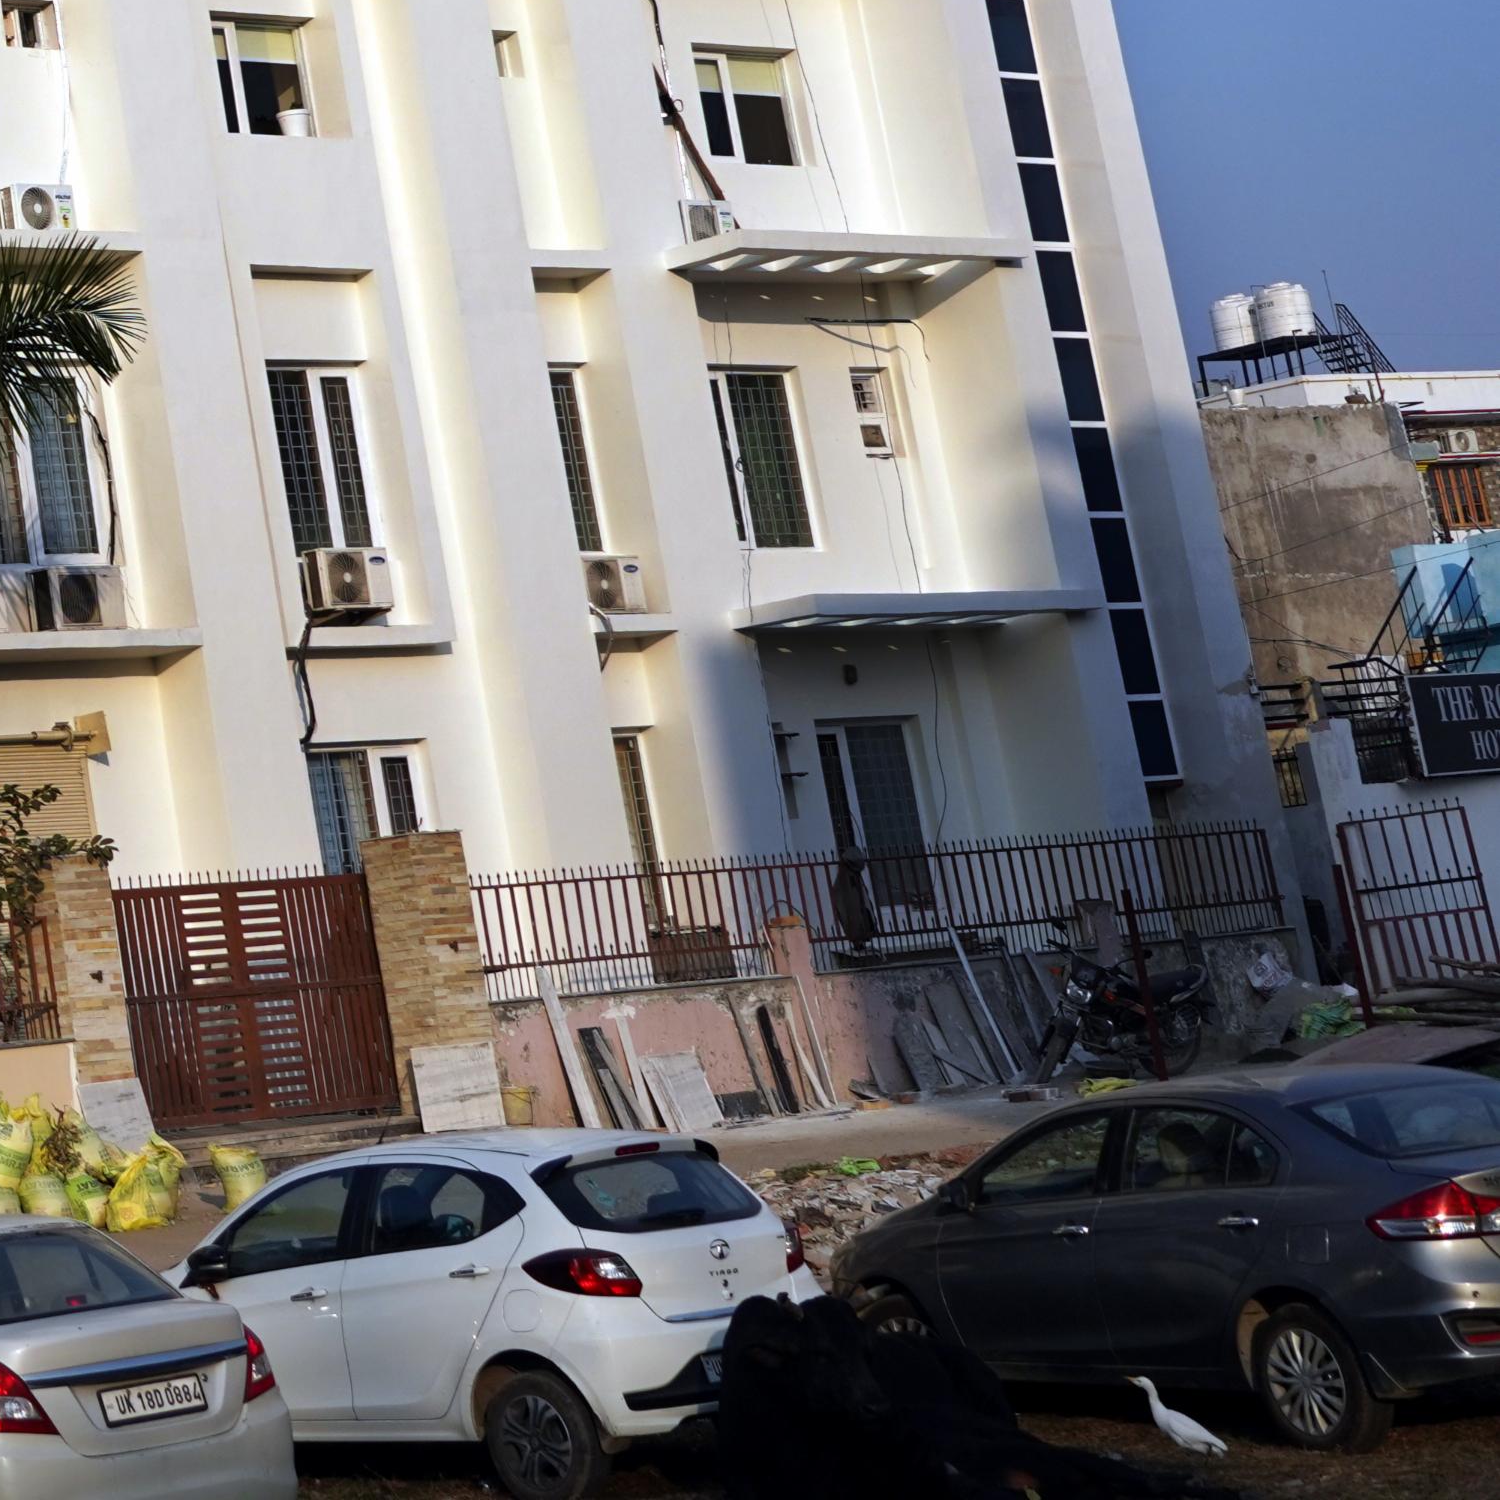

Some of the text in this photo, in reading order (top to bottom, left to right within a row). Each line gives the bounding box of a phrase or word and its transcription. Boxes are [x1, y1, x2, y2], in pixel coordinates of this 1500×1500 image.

[1432, 686, 1479, 721] THE
[709, 1267, 739, 1277] TIAGO
[115, 1391, 136, 1414] UK
